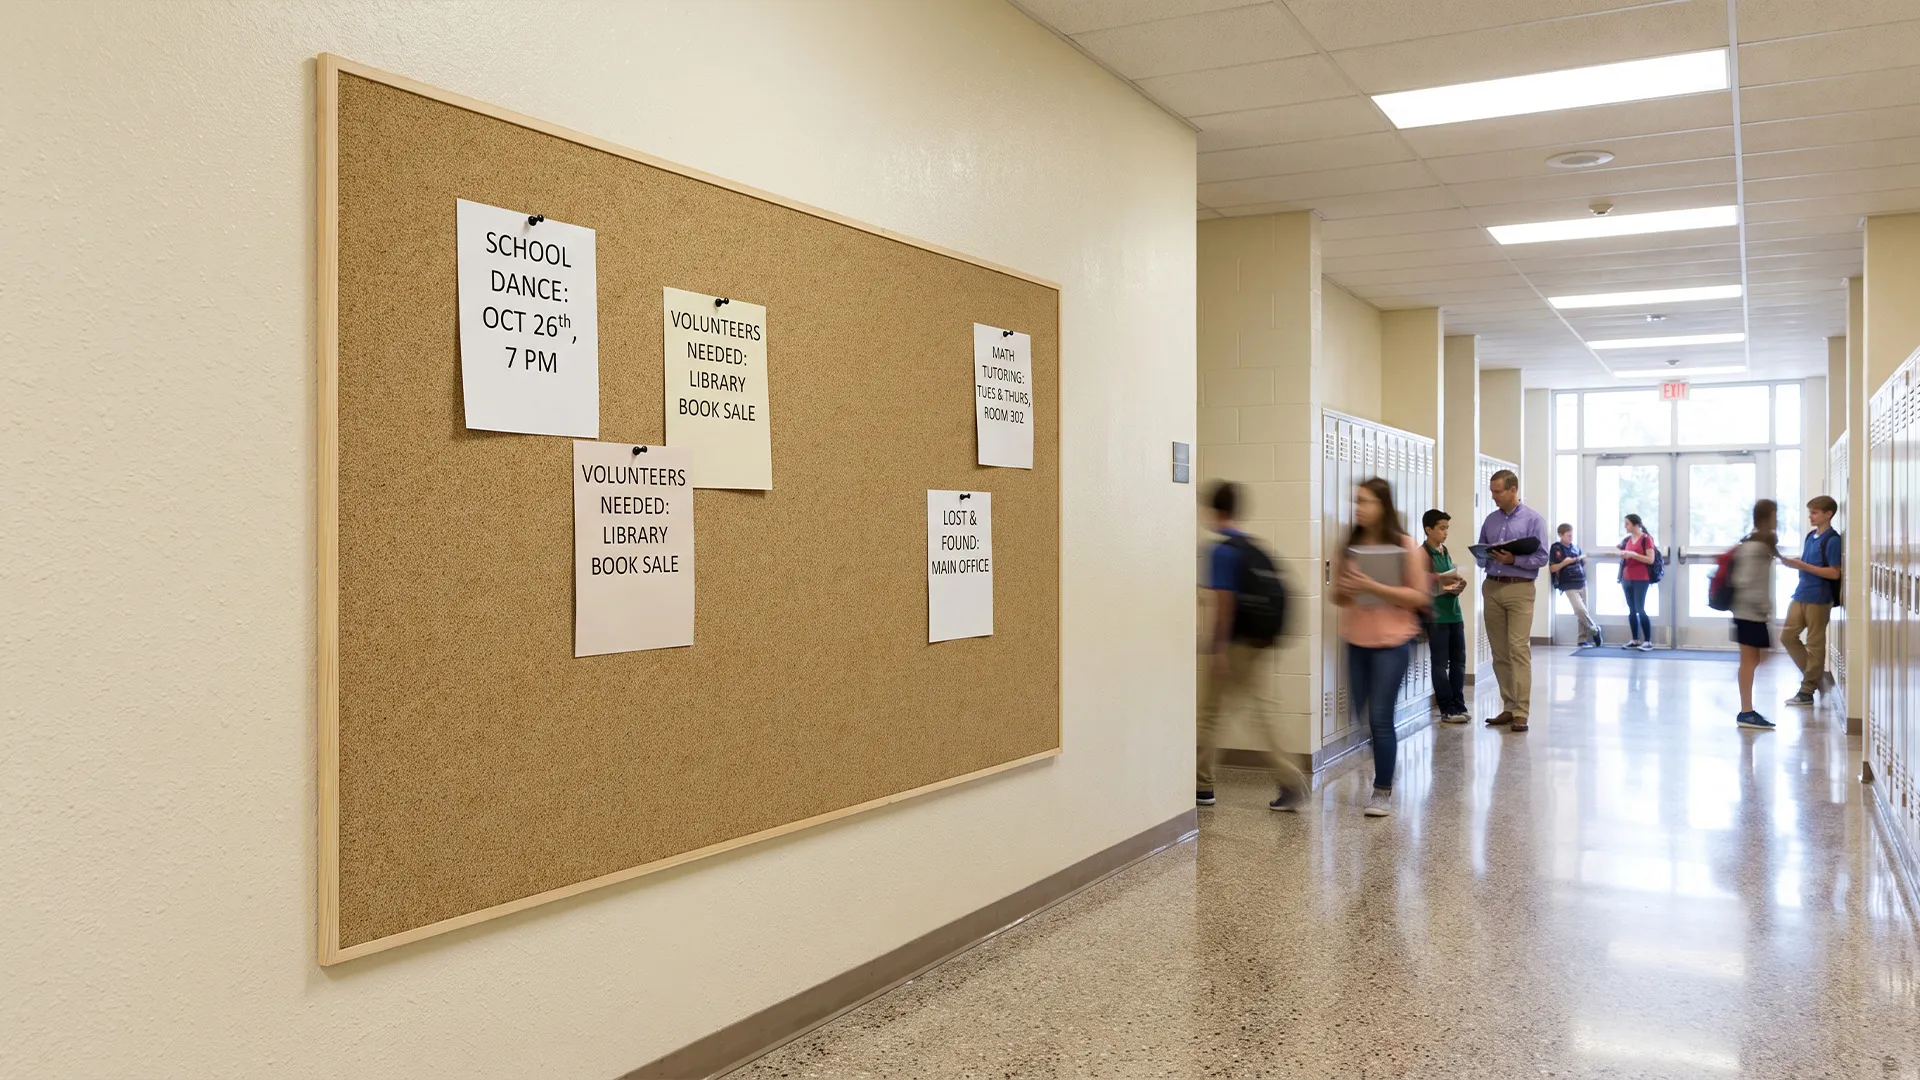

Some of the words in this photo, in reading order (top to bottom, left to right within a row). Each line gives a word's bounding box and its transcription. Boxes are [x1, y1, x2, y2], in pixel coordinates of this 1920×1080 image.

[486, 232, 571, 268] SCHOOL
[491, 270, 568, 303] DANCE:
[483, 307, 526, 332] OCT
[534, 313, 577, 344] 26th,
[671, 310, 760, 341] VOLUNTEERS
[506, 347, 517, 368] 7
[525, 349, 557, 373] PM
[688, 342, 747, 366] NEEDED:
[992, 346, 1015, 362] MATH
[690, 370, 746, 392] LIBRARY
[982, 365, 1025, 384] TUTORING:
[977, 385, 996, 399] TUES
[997, 388, 1004, 401] &
[1004, 390, 1031, 407] THURS,
[1663, 383, 1687, 399] EXIT
[679, 398, 719, 418] BOOK
[723, 402, 755, 421] SALE
[984, 406, 1009, 421] ROOM
[1010, 410, 1024, 424] 302
[581, 464, 686, 486] VOLUNTEERS
[600, 496, 670, 515] NEEDED:
[943, 510, 967, 525] LOST
[969, 510, 977, 525] &
[604, 526, 669, 545] LIBRARY
[942, 535, 980, 551] FOUND:
[592, 556, 638, 575] BOOK
[642, 555, 678, 573] SALE
[931, 560, 956, 575] MAIN
[958, 558, 989, 574] OFFICE
